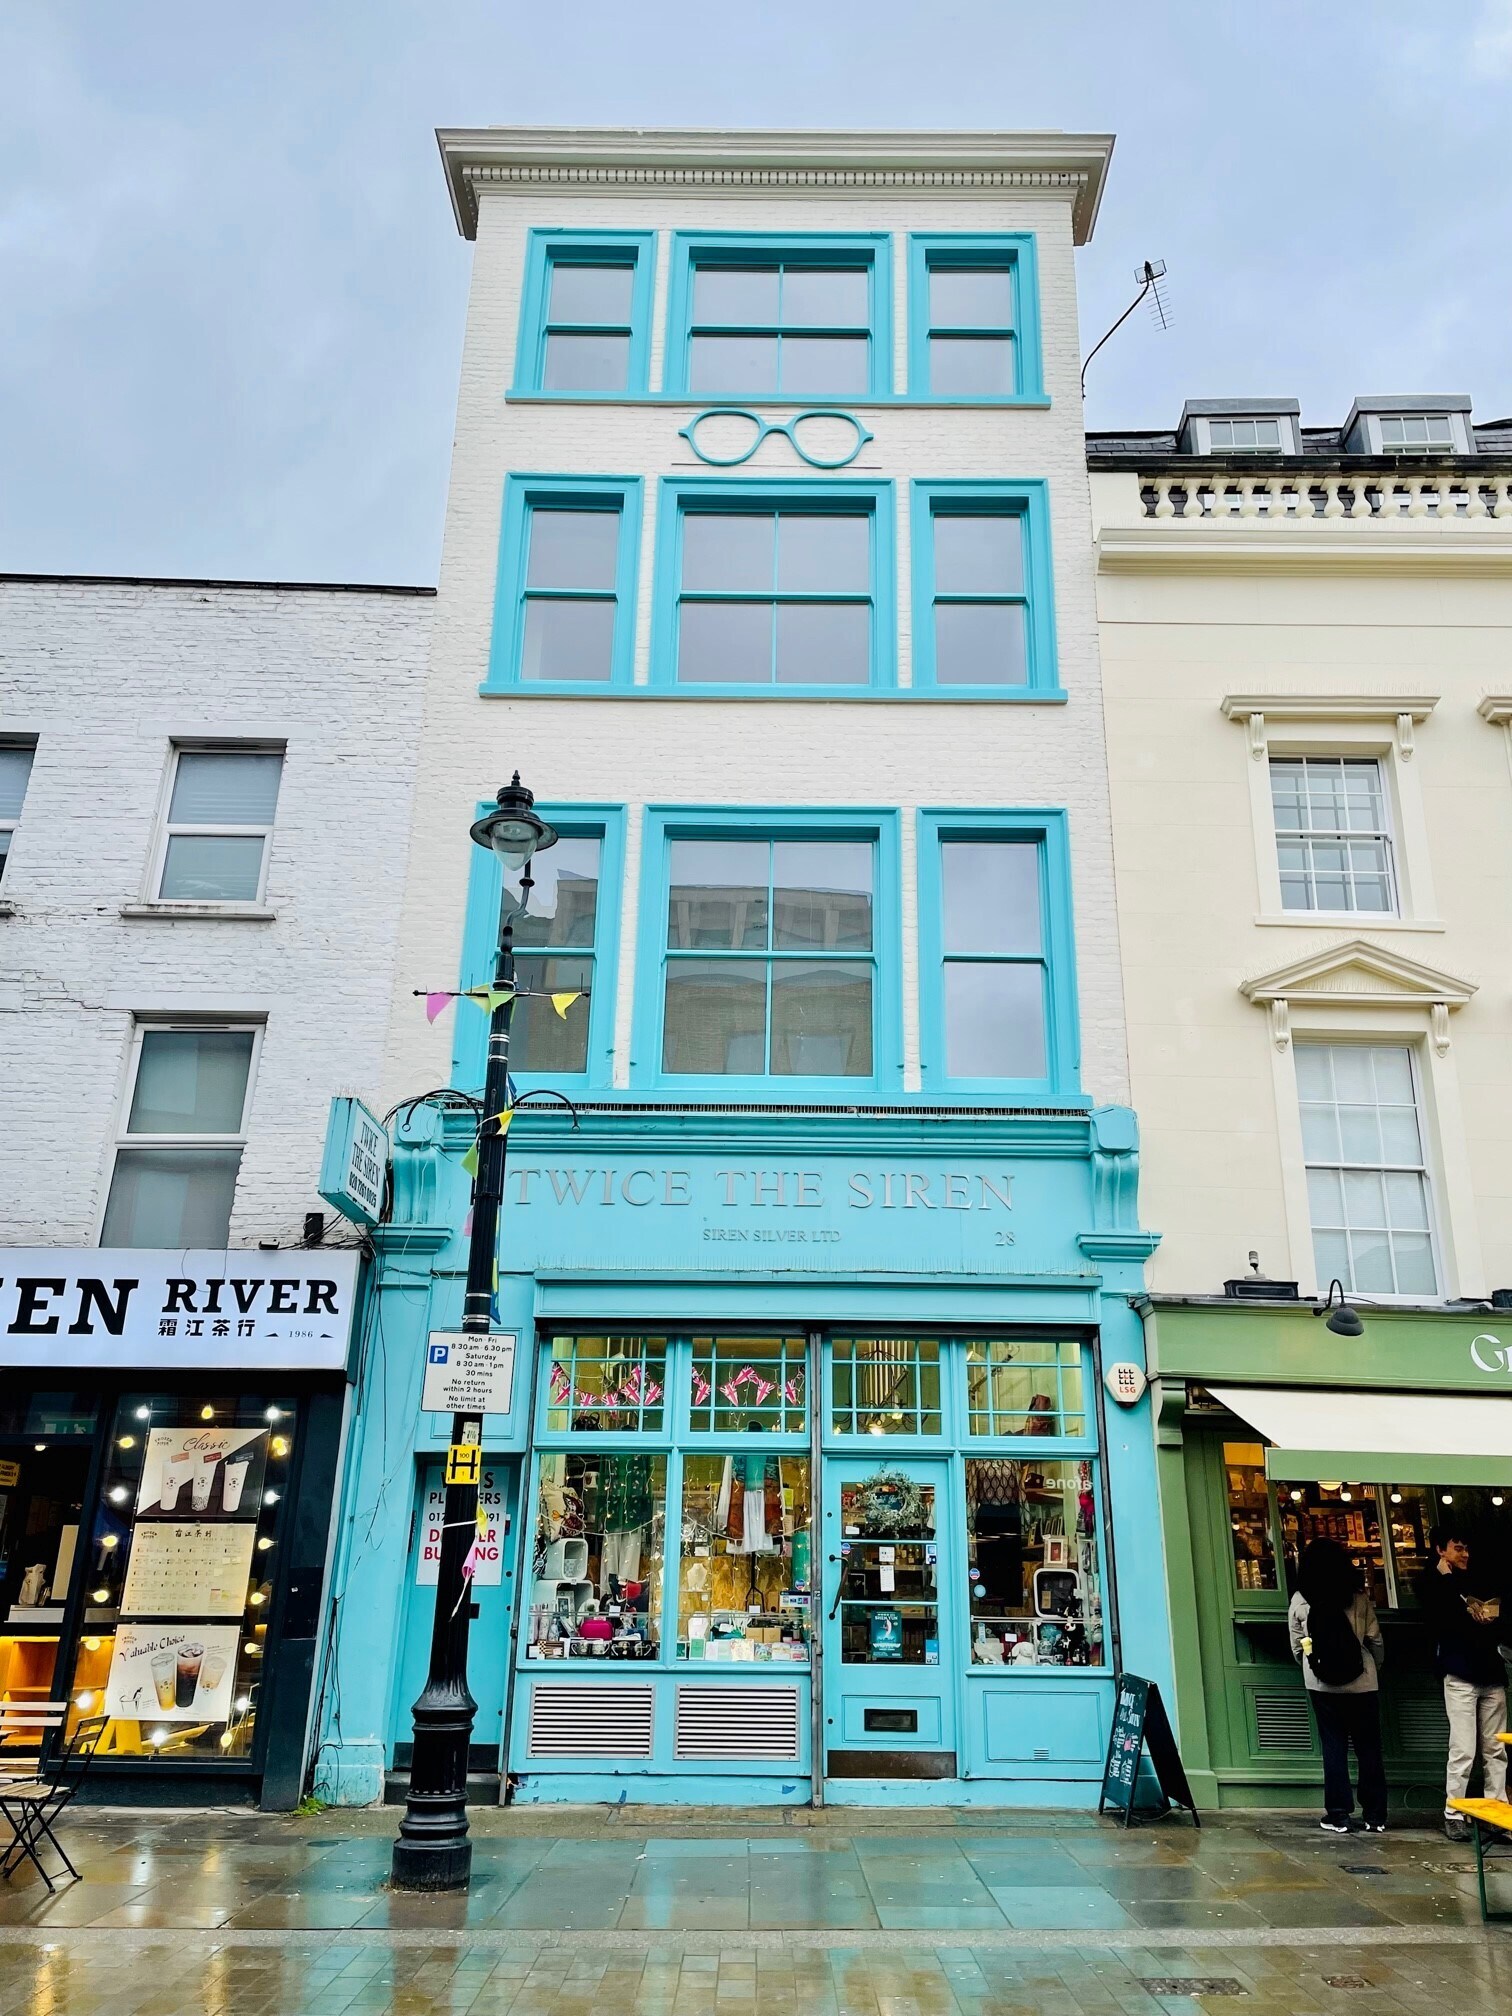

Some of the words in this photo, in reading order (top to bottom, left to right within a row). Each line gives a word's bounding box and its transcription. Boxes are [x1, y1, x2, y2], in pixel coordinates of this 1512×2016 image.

[351, 1142, 362, 1172] THE
[362, 1154, 380, 1188] SIREN
[508, 1168, 693, 1207] TWICE
[714, 1169, 824, 1208] THE
[848, 1172, 1016, 1211] SIREN
[702, 1228, 749, 1242] SIREN
[752, 1229, 808, 1243] SILVER
[811, 1230, 842, 1243] LTD
[994, 1230, 1016, 1247] 28
[0, 1278, 140, 1336] EN
[161, 1278, 340, 1315] RIVER
[157, 1317, 256, 1338] 霜江茶行
[288, 1329, 314, 1339] 1986
[467, 1335, 483, 1343] Mon
[487, 1336, 497, 1344] Fri
[433, 1347, 446, 1363] P
[465, 1352, 497, 1361] Saturday
[451, 1378, 462, 1386] No
[1119, 1386, 1136, 1394] LSG
[460, 1395, 476, 1403] limit
[182, 1432, 231, 1452] Classic
[159, 1635, 186, 1650] Choice
